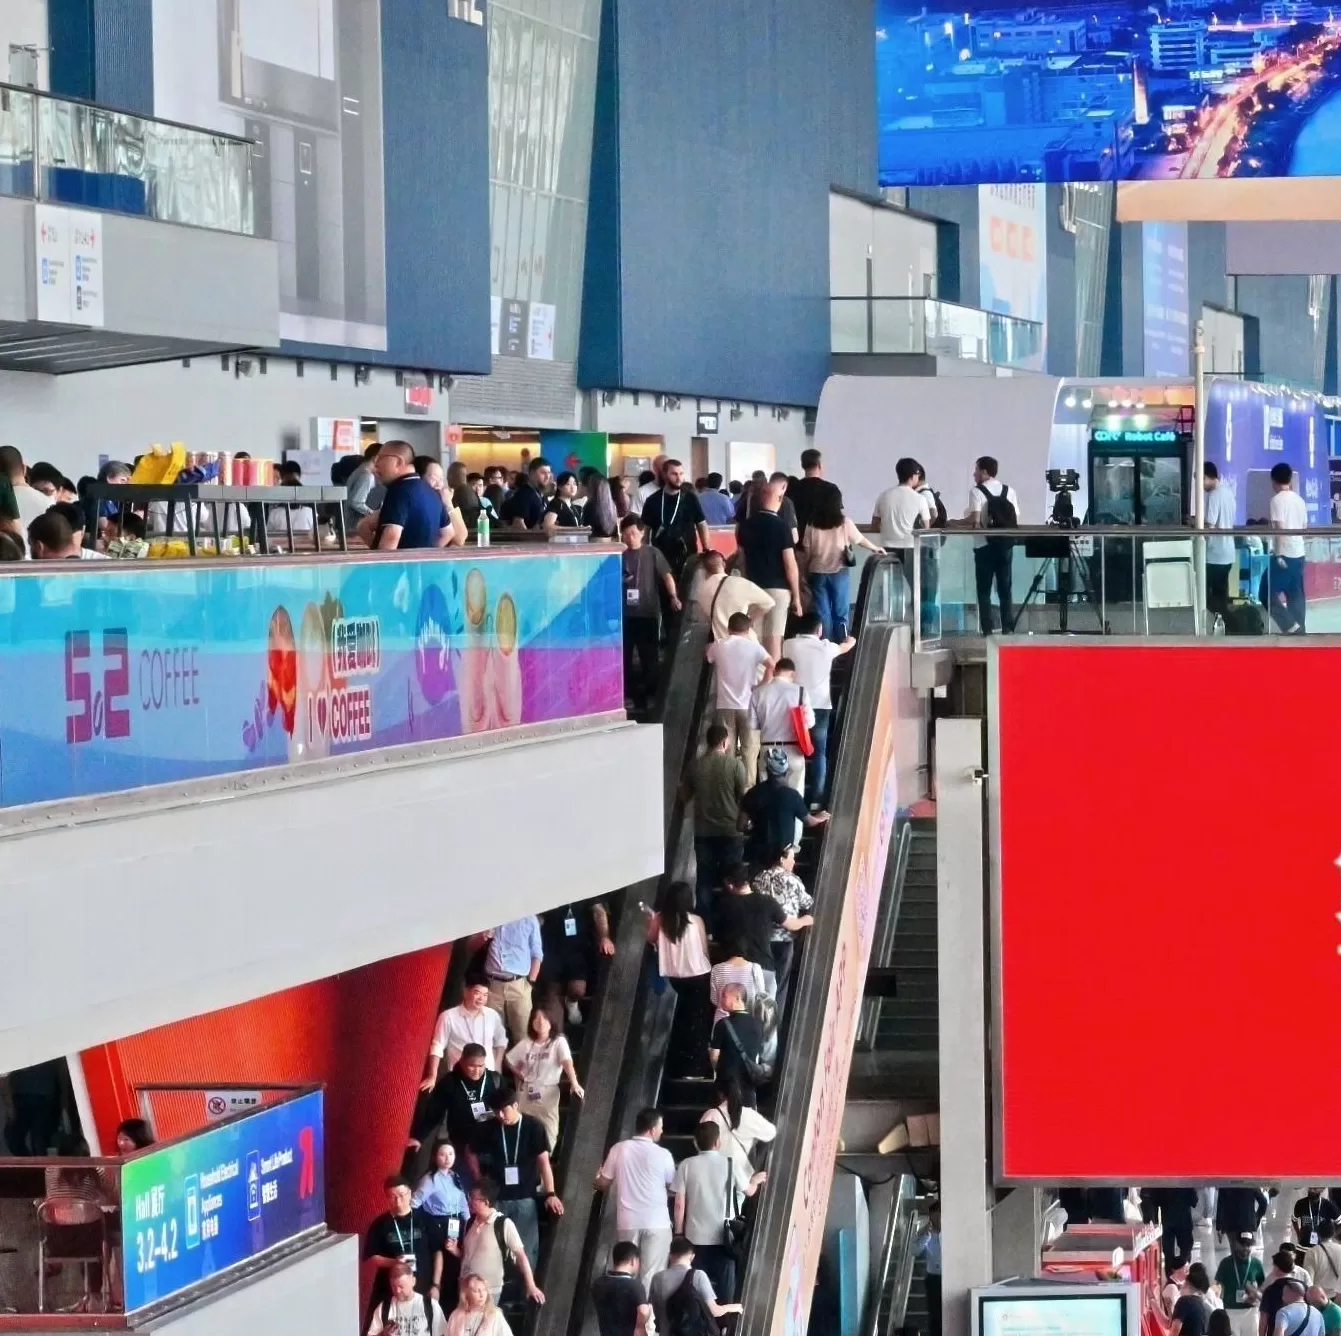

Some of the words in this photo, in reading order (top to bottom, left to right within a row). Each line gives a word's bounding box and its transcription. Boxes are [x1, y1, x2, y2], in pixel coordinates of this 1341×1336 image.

[138, 646, 200, 711] COFFEE
[330, 687, 371, 743] COFFEE
[136, 1217, 179, 1274] 3.2-4.2
